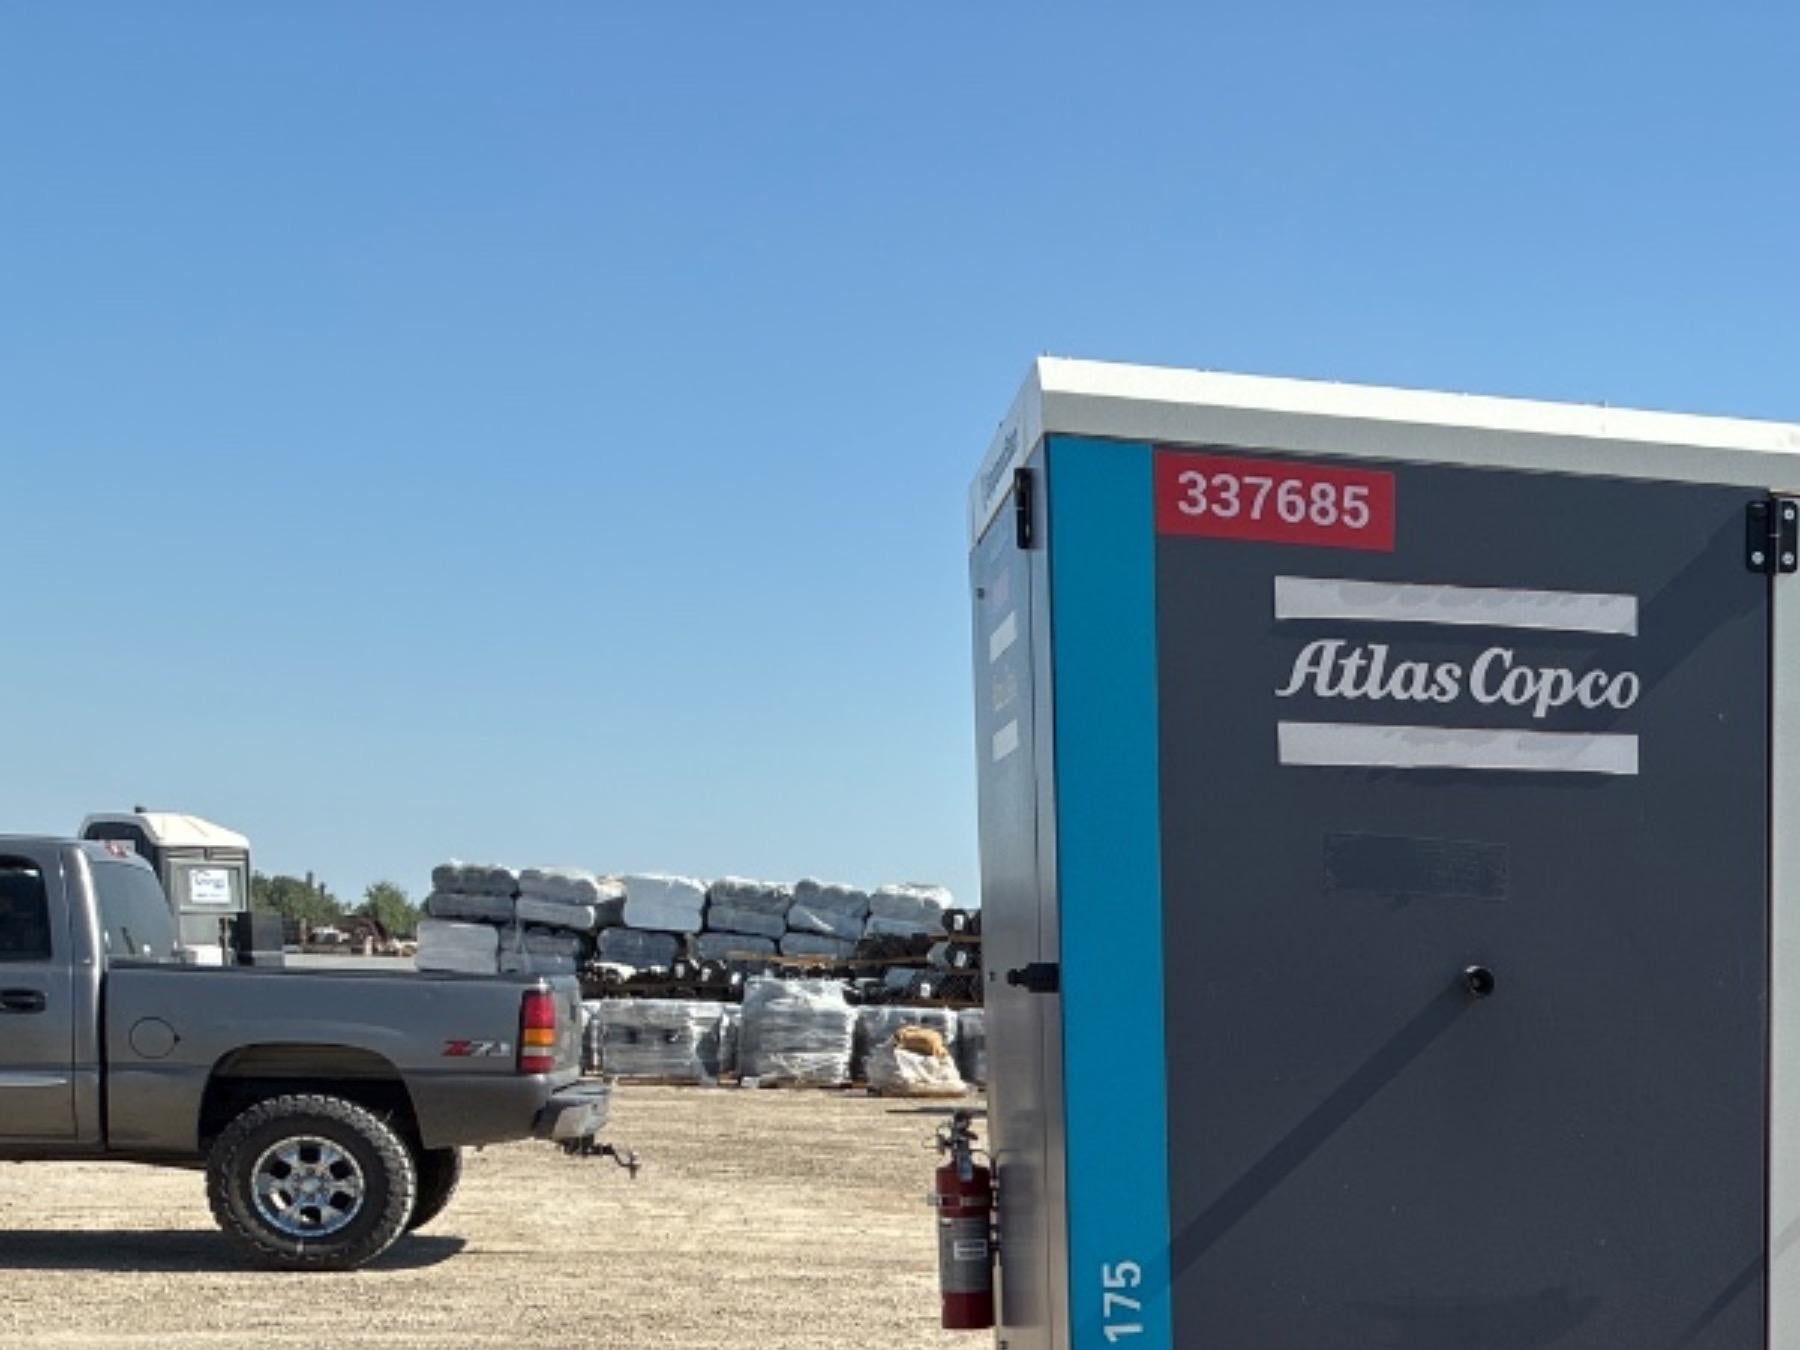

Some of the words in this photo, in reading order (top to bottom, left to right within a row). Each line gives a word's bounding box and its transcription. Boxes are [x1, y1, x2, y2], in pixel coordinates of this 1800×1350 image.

[1178, 470, 1370, 529] 337685
[1275, 638, 1462, 702] Atlas
[1469, 646, 1640, 718] Copco
[1103, 1259, 1144, 1343] 175
